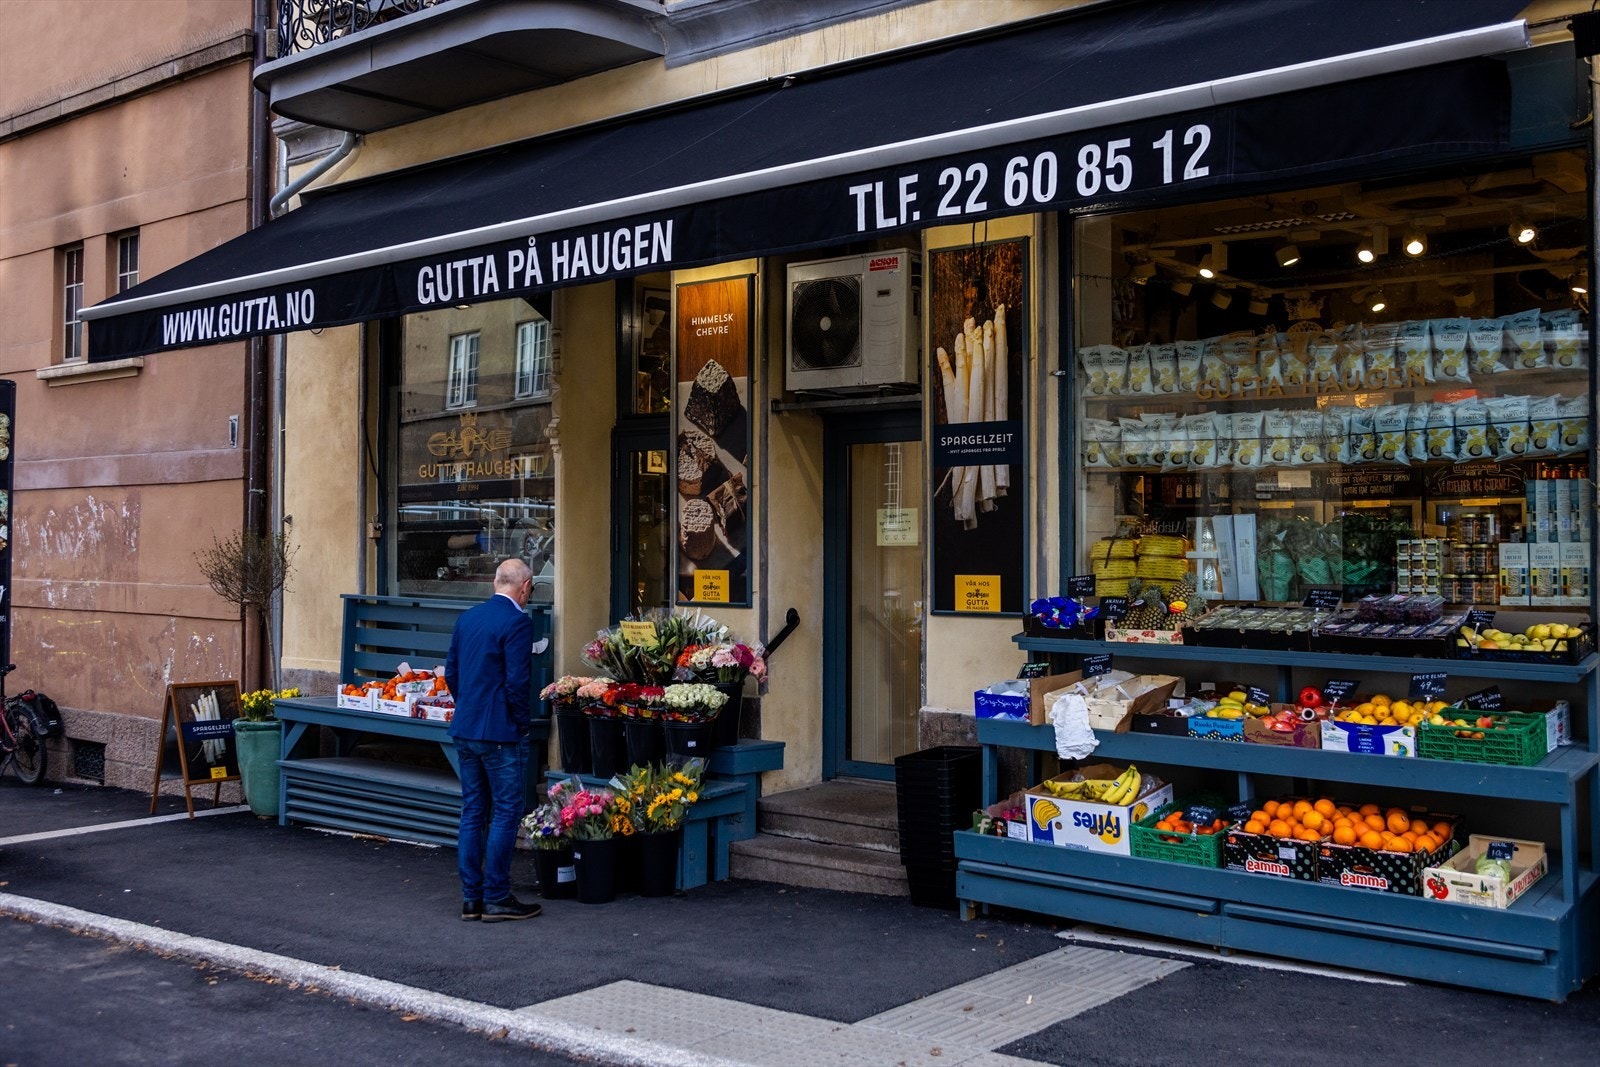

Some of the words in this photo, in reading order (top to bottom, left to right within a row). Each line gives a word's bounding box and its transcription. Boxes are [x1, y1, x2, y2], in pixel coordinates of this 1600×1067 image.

[848, 174, 920, 232] TLF.
[936, 162, 989, 217] 22
[1003, 150, 1058, 207] 60
[1076, 137, 1132, 197] 85
[1152, 123, 1212, 184] 12
[417, 254, 500, 305] GUTTA
[508, 236, 543, 289] PÅ
[551, 219, 674, 282] HAUGEN
[162, 288, 315, 345] WWW.GUTTA.NO
[691, 312, 734, 326] HIMMELSK
[695, 325, 729, 337] CHEVRE
[1196, 376, 1286, 400] GUTTA
[1302, 366, 1427, 395] HAUGEN
[940, 433, 1013, 446] SPARGELZEIT
[418, 463, 458, 478] GUTTA
[466, 459, 523, 476] HAUGEN
[192, 723, 231, 733] SPARGELZEIT
[1246, 860, 1289, 876] gamma
[1341, 873, 1388, 890] gamma
[1513, 862, 1542, 895] PROVENCE
